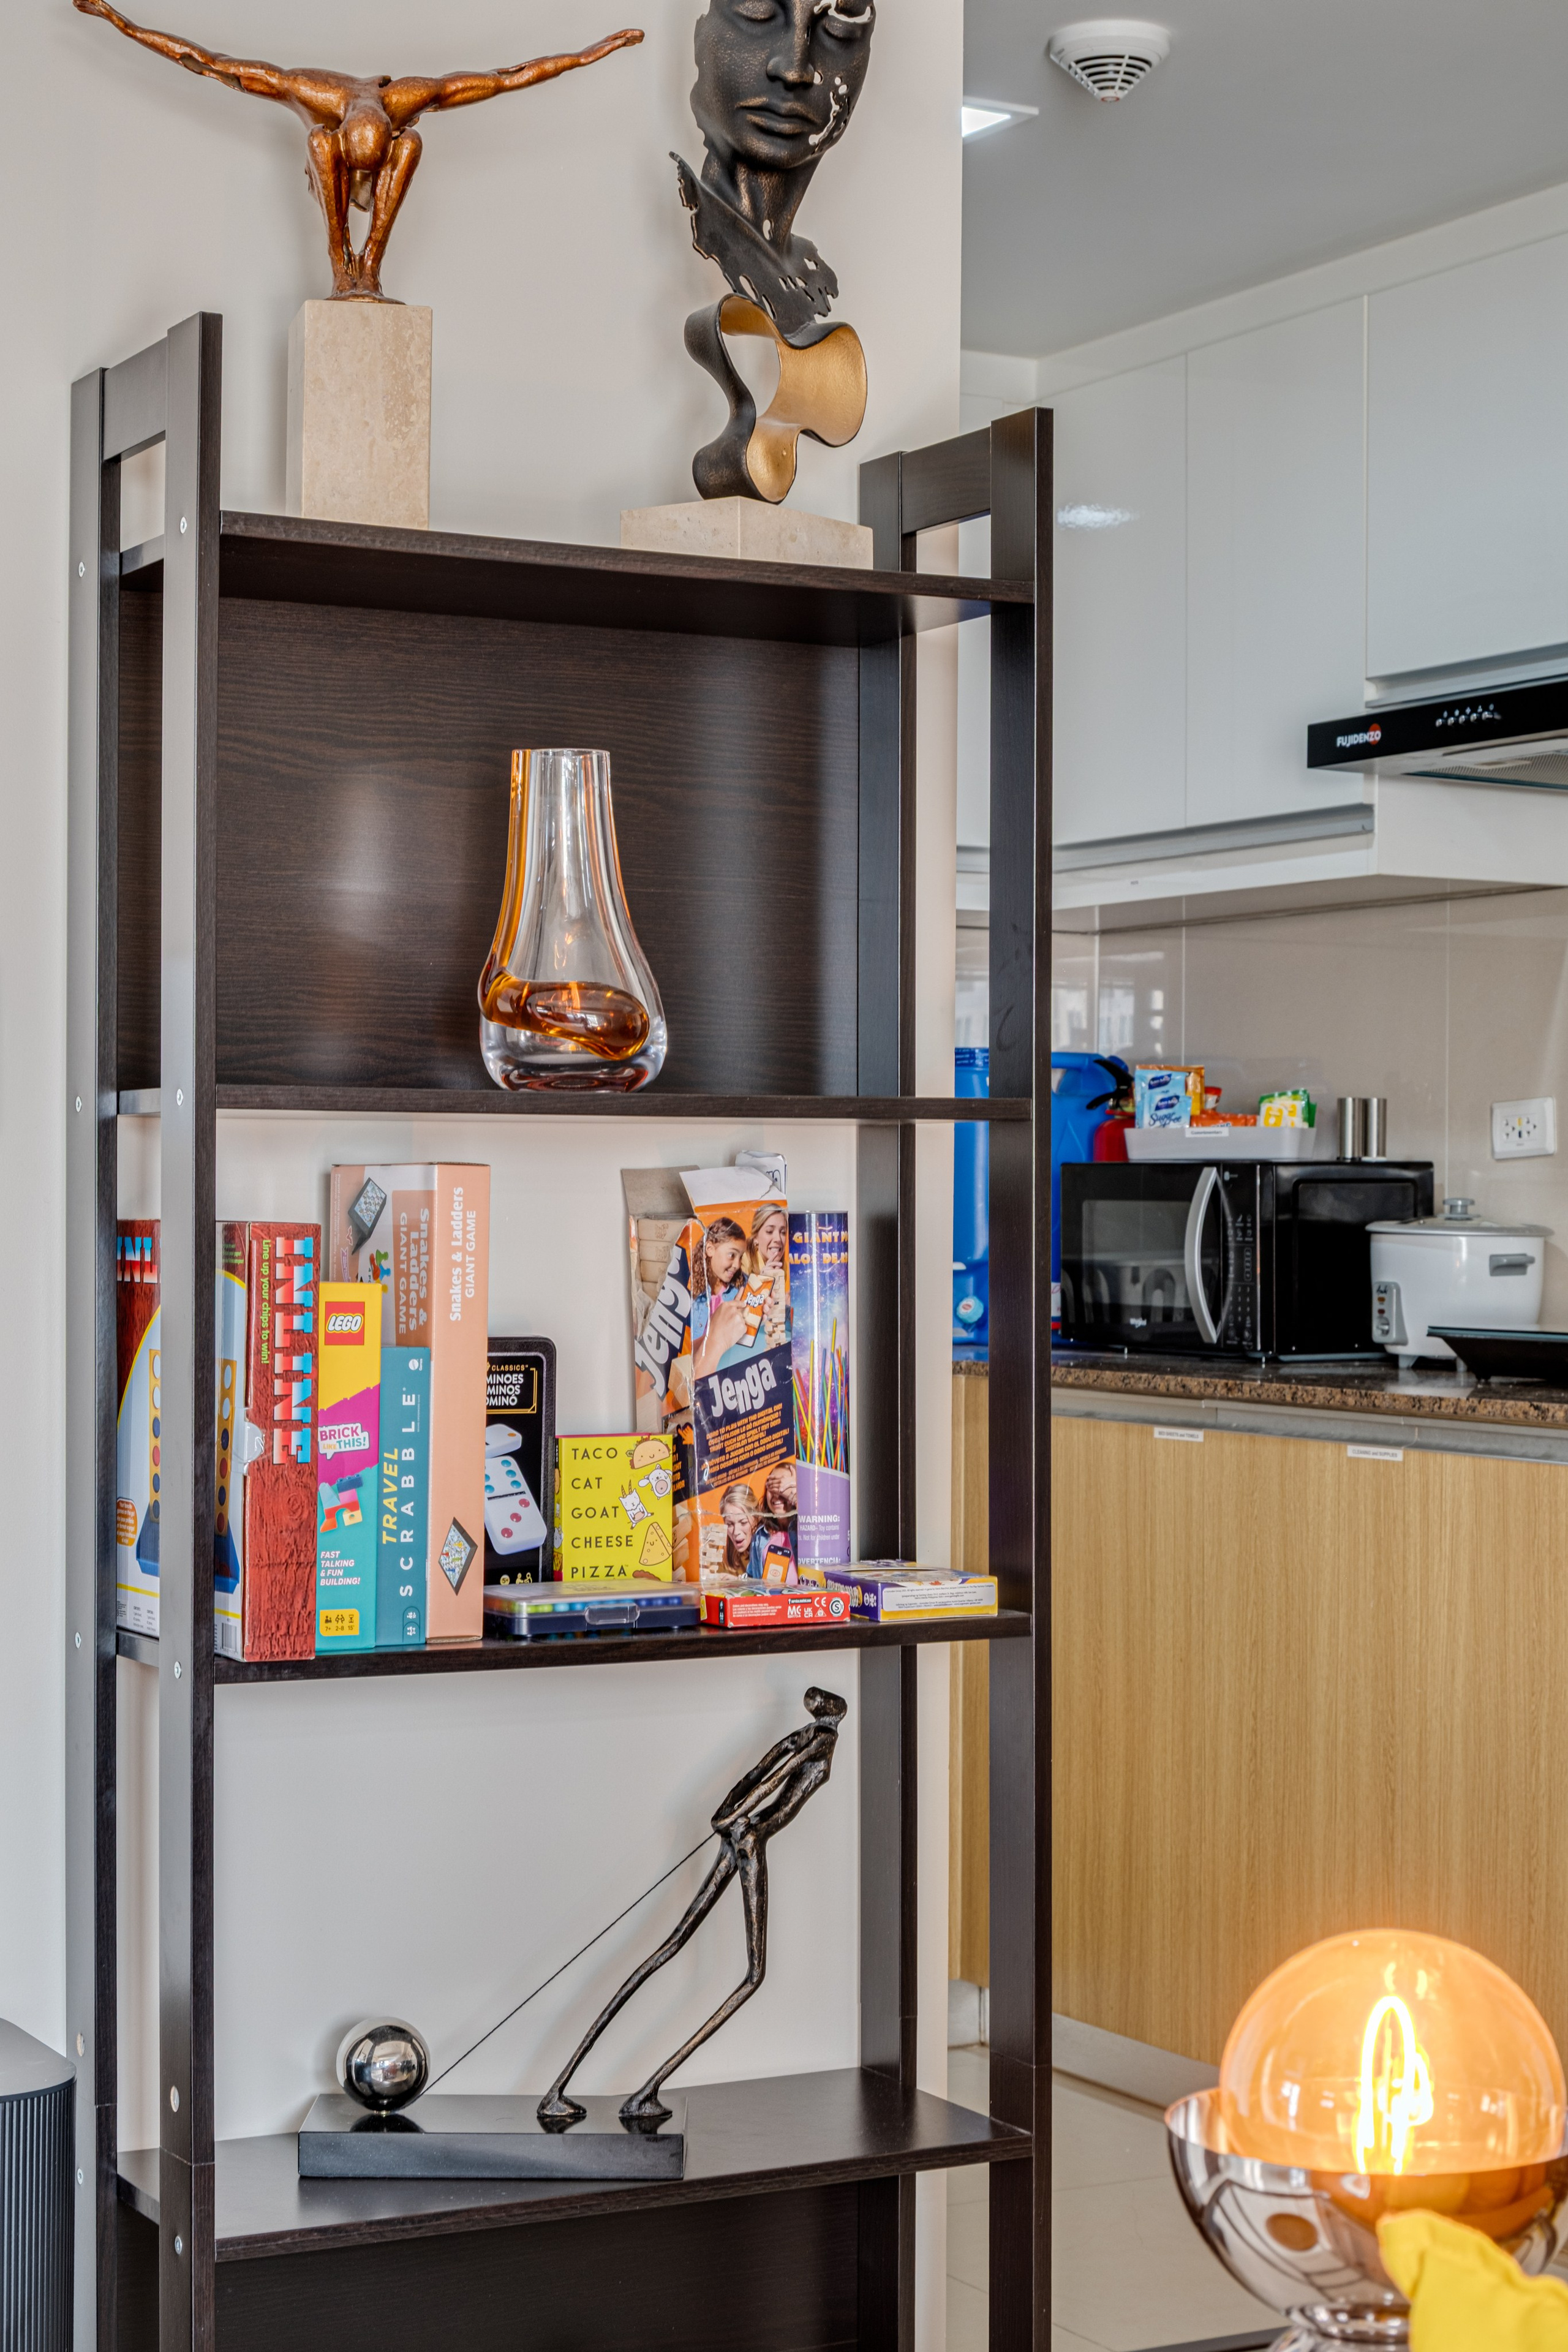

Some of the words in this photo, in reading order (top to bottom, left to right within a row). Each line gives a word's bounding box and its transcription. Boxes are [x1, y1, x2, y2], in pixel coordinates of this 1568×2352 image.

[1336, 730, 1381, 748] FUJIDENZO
[1148, 1112, 1175, 1127] Sugar
[1163, 1115, 1182, 1128] free
[451, 1187, 463, 1246] Ladders
[466, 1210, 476, 1251] GAME
[793, 1231, 840, 1243] GIANT
[262, 1240, 271, 1260] Line
[419, 1208, 429, 1299] Snakes
[451, 1251, 462, 1262] &
[823, 1253, 838, 1264] DE
[117, 1236, 160, 1284] INL
[260, 1264, 270, 1275] up
[465, 1254, 475, 1298] GIANT
[260, 1278, 270, 1300] your
[409, 1231, 419, 1331] Ladders
[450, 1267, 462, 1321] Snakes
[744, 1291, 764, 1308] Jenga
[259, 1302, 271, 1328] chips
[327, 1314, 363, 1332] LEGO
[419, 1308, 427, 1326] &
[261, 1330, 270, 1340] to
[261, 1342, 270, 1364] win!
[273, 1237, 314, 1464] INLINE
[487, 1384, 521, 1395] MINOS
[708, 1358, 777, 1417] Jenga
[737, 1417, 748, 1428] WITH
[319, 1425, 359, 1442] BRICK
[336, 1436, 366, 1450] THIS!
[571, 1447, 618, 1460] TACO
[571, 1477, 603, 1490] CAT
[382, 1447, 398, 1544] TRAVEL
[399, 1394, 415, 1597] SCRABBLE
[571, 1506, 619, 1520] GOAT
[798, 1514, 840, 1523] WARNING:
[571, 1535, 633, 1549] CHEESE
[321, 1559, 355, 1568] TALKING
[320, 1577, 361, 1586] BUILDING!
